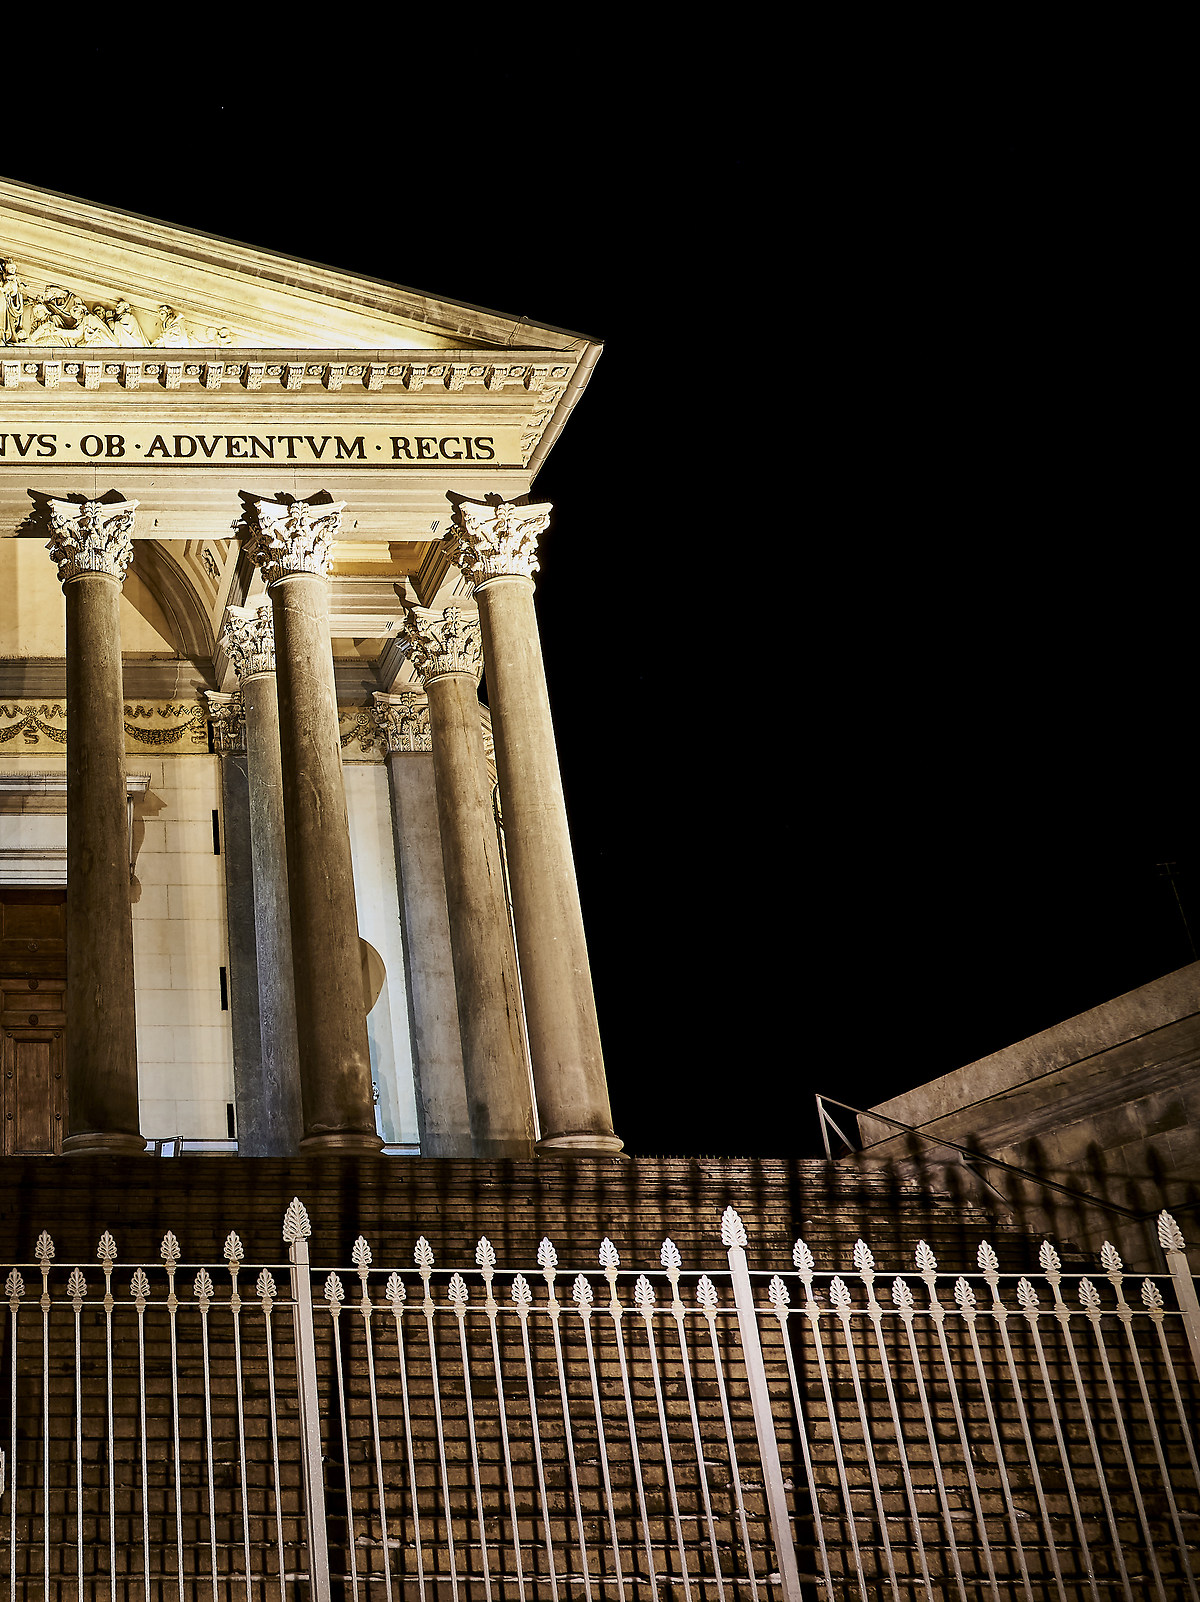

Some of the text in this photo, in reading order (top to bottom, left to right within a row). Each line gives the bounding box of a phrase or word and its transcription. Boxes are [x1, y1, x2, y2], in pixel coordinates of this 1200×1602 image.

[79, 434, 126, 458] OB
[144, 434, 368, 460] ADVENTVM
[388, 436, 495, 460] REGIS
